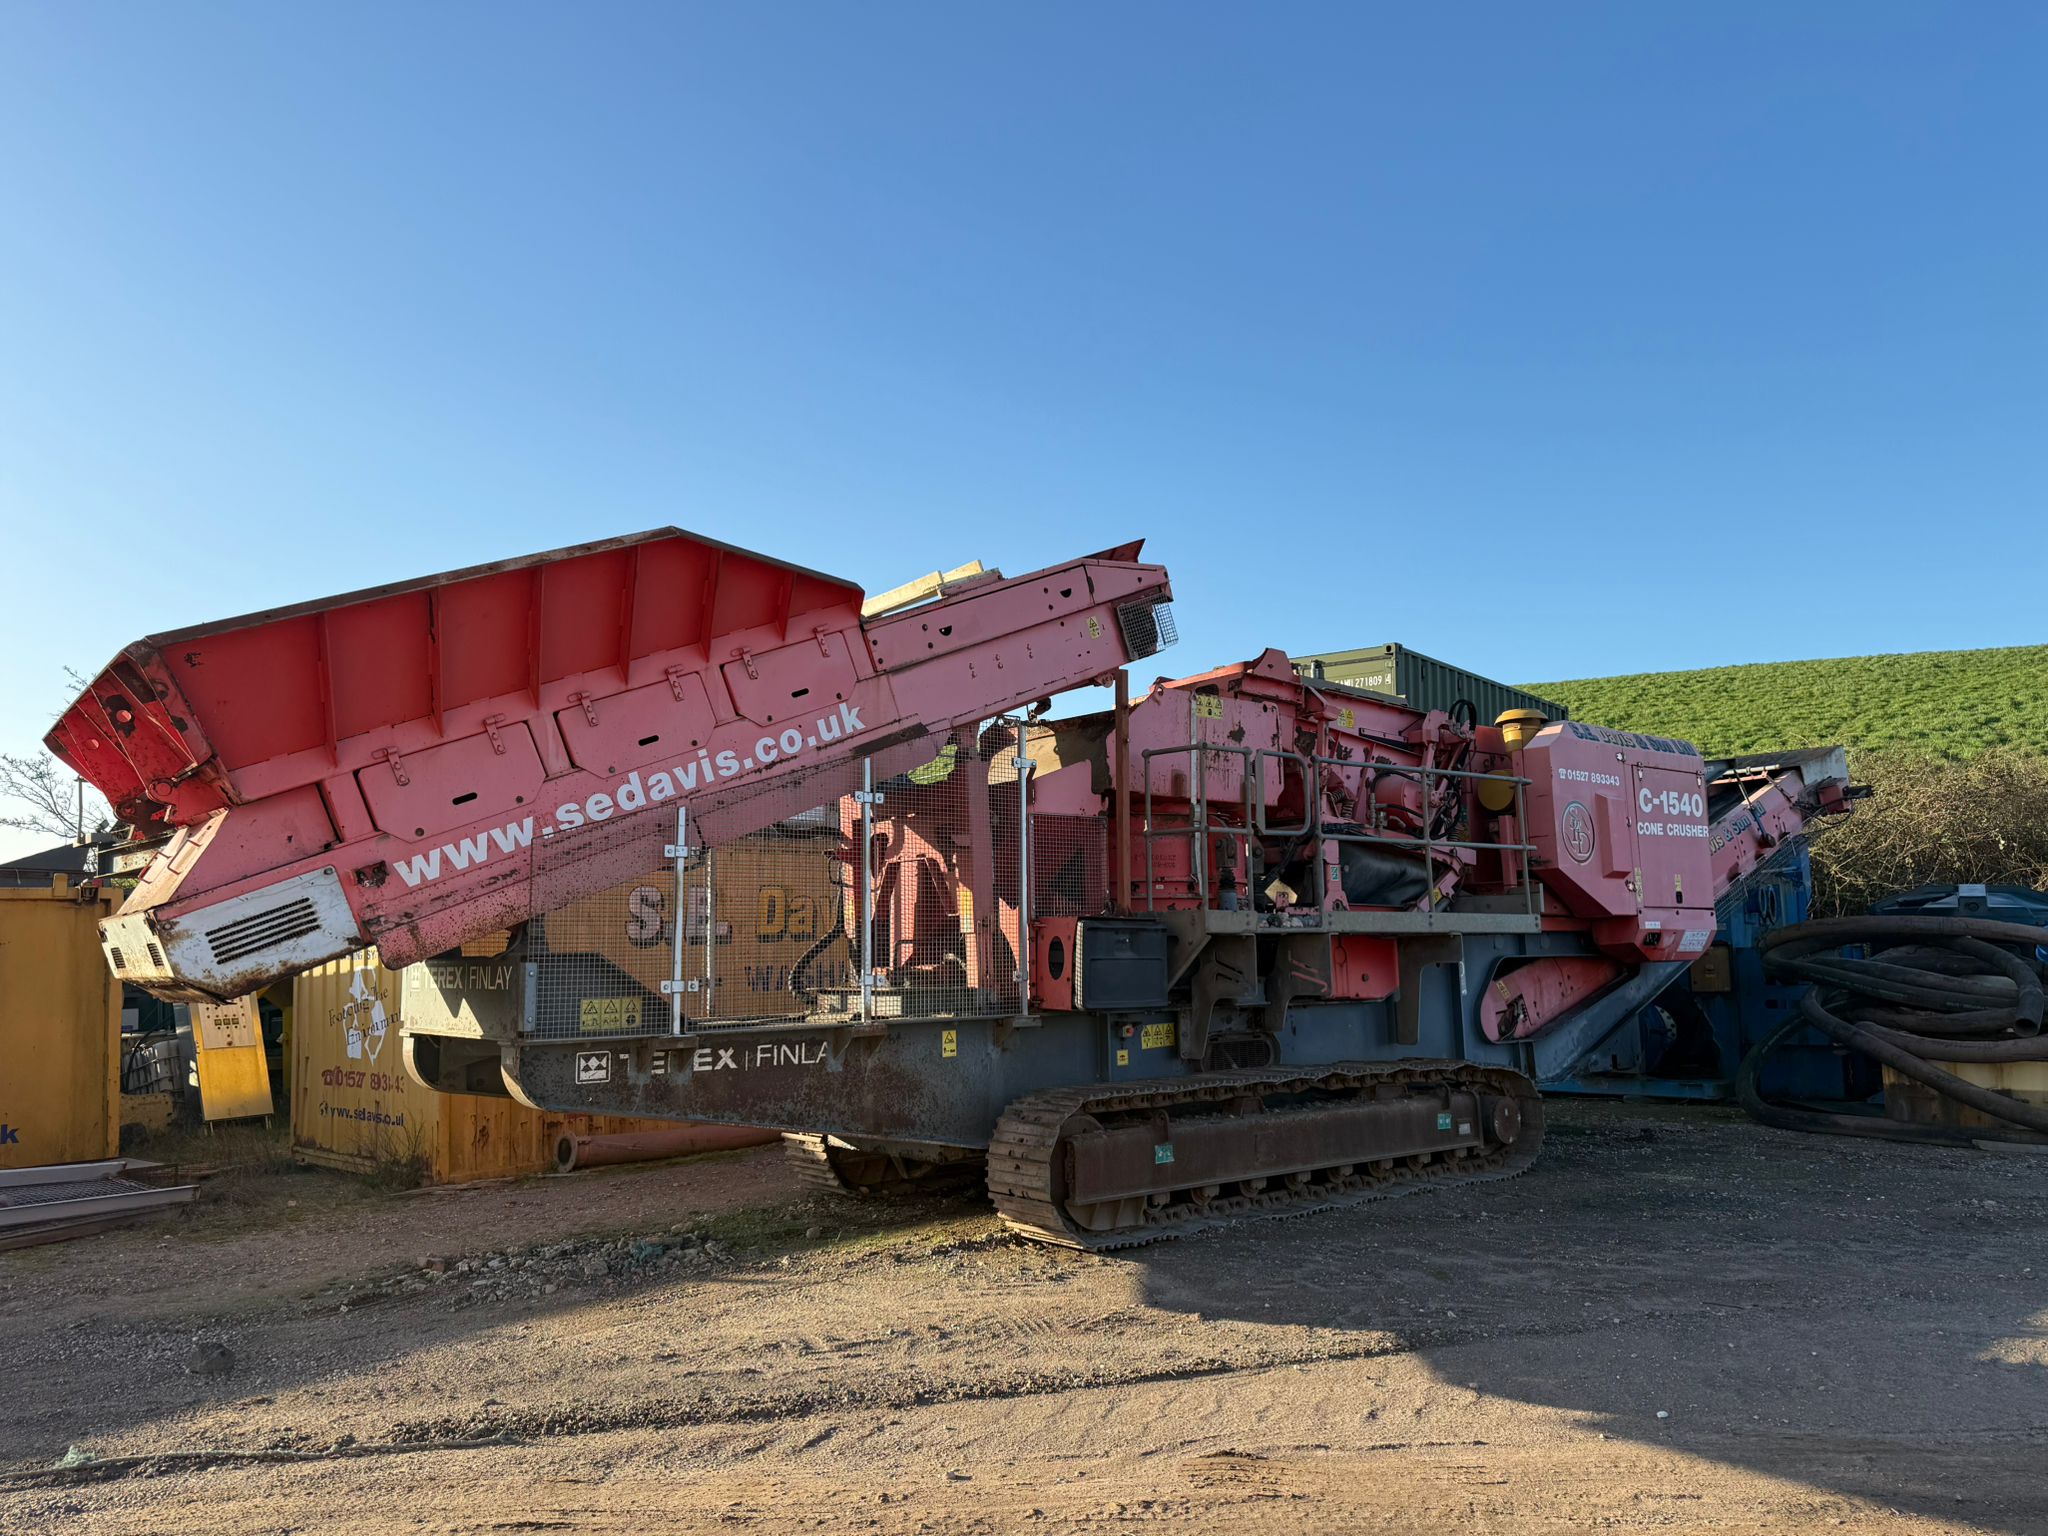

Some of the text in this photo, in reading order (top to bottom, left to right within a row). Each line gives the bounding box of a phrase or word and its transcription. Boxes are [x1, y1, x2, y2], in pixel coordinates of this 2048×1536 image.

[1355, 676, 1382, 688] 271809
[1600, 729, 1636, 748] Davis
[1646, 736, 1676, 753] Son
[1567, 771, 1620, 786] 01527 893343
[393, 702, 866, 887] www.sedavis.co.uk
[1639, 788, 1704, 818] C-1540
[1637, 821, 1709, 837] CONE CRUSHER
[1709, 836, 1725, 856] vis
[1723, 826, 1734, 842] &
[1732, 815, 1752, 836] Son
[423, 966, 512, 990] TEREX FINLAY
[756, 1040, 829, 1068] FINLA
